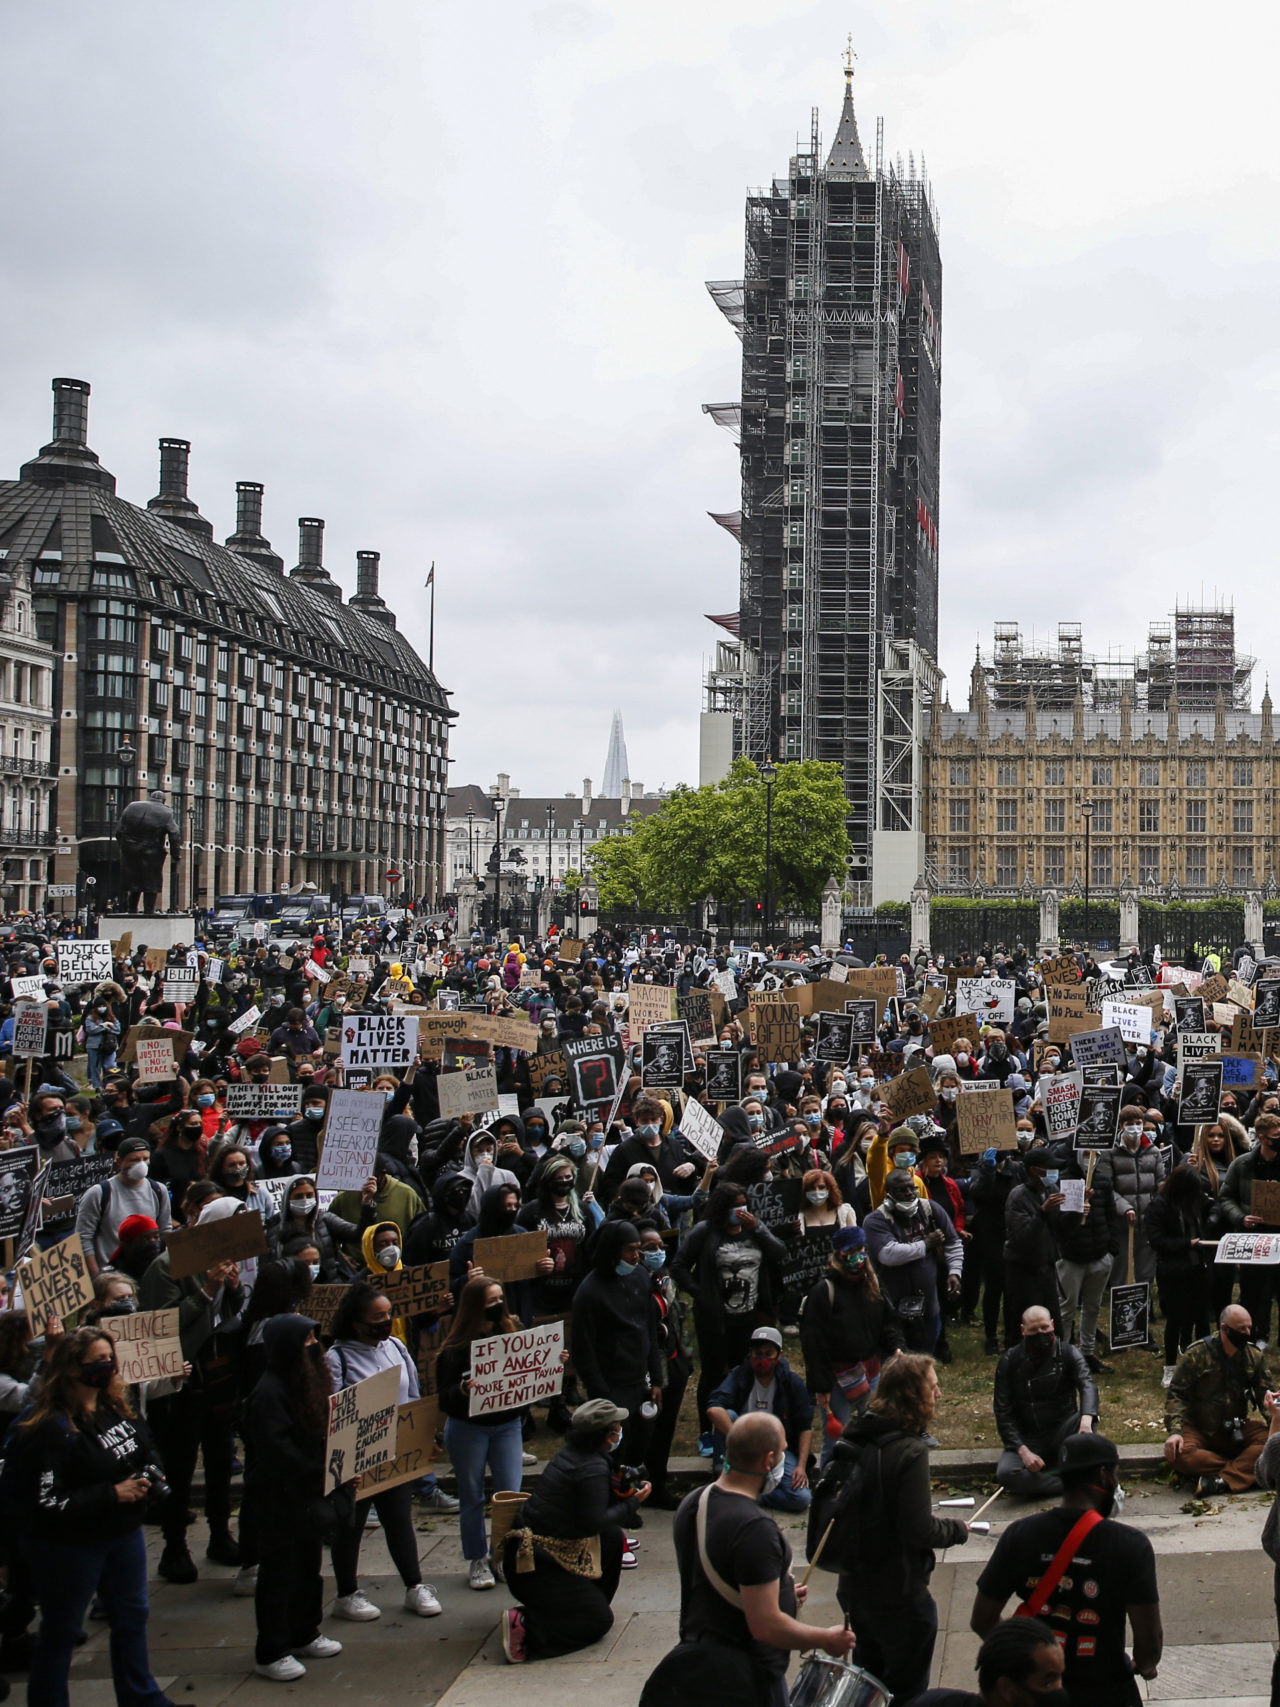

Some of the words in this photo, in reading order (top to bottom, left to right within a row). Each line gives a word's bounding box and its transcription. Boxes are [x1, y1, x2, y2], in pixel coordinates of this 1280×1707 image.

[58, 944, 110, 954] JUSTICE
[61, 960, 109, 971] BELLY
[1041, 957, 1075, 975] BLACK
[60, 971, 113, 982] MUJINGA
[169, 968, 192, 980] BLM
[850, 969, 869, 981] WHITE
[871, 969, 895, 981] SILENCE
[1044, 968, 1079, 986] LIVES
[390, 983, 409, 992] BLM
[961, 979, 983, 988] NAZI
[990, 980, 1013, 989] COPS
[750, 993, 778, 1002] WHITE
[1052, 989, 1062, 999] NO
[634, 1009, 663, 1018] WORSE
[757, 1003, 800, 1023] YOUNG
[988, 1012, 1005, 1020] OFF
[1052, 1006, 1062, 1016] NO
[1065, 1008, 1084, 1018] PEACE
[1112, 1006, 1138, 1015] BLACK
[358, 1017, 405, 1031] BLACK
[428, 1018, 468, 1033] enough
[695, 1021, 713, 1032] THIS
[931, 1018, 973, 1034] BLACK
[1111, 1017, 1138, 1027] LIVES
[357, 1032, 405, 1046] LIVES
[757, 1023, 800, 1044] GIFTED
[933, 1030, 974, 1043] LIVES
[1182, 1035, 1217, 1044] BLACK
[1239, 1031, 1280, 1042] LIVES
[566, 1036, 605, 1056] WHERE
[606, 1035, 618, 1049] IS
[1074, 1037, 1096, 1047] THERE
[1075, 1046, 1094, 1055] TIME
[1097, 1043, 1116, 1052] WHEN
[139, 1050, 172, 1059] JUSTICE
[350, 1049, 410, 1064] MATTER
[758, 1044, 800, 1064] BLACK
[1077, 1052, 1108, 1063] SILENCE
[1112, 1048, 1121, 1056] IS
[1183, 1047, 1216, 1057] LIVES
[145, 1065, 169, 1073] PEACE
[528, 1052, 567, 1073] BLACK
[466, 1069, 493, 1082] BLACK
[231, 1085, 253, 1093] THEY
[258, 1085, 279, 1093] KILL
[282, 1085, 298, 1093] OUR
[881, 1073, 920, 1096] BLACK
[1048, 1083, 1076, 1097] SMASH
[276, 1094, 299, 1102] MAKE
[467, 1088, 496, 1101] MATTER
[1046, 1091, 1080, 1105] RACISM!
[957, 1103, 994, 1114] RACISM
[1050, 1101, 1073, 1114] JOBS
[573, 1108, 599, 1124] THE
[688, 1100, 724, 1144] SILENCE
[959, 1116, 972, 1127] TO
[972, 1114, 994, 1128] DENY
[993, 1112, 1015, 1125] THAT
[335, 1117, 360, 1132] SEE
[359, 1117, 382, 1132] YOU
[1050, 1120, 1069, 1133] FOR
[680, 1122, 716, 1158] VIOLENCE
[960, 1128, 996, 1139] RACISM
[330, 1134, 363, 1149] HEAR
[960, 1137, 1001, 1150] EXISTS
[335, 1151, 374, 1165] STAND
[322, 1165, 353, 1178] WITH
[20, 1243, 71, 1290] BLACK
[370, 1266, 433, 1290] BLACK
[29, 1268, 73, 1308] LIVES
[412, 1279, 447, 1296] LIVES
[31, 1281, 88, 1337] MATTER
[108, 1313, 173, 1342] SILENCE
[136, 1343, 150, 1357] IS
[475, 1341, 497, 1358] IF
[501, 1333, 535, 1354] YOU
[536, 1333, 560, 1346] are
[119, 1351, 179, 1381] VIOLENCE
[475, 1360, 499, 1377] NOT
[508, 1375, 528, 1389] NOT
[534, 1366, 564, 1381] PAYING
[331, 1386, 358, 1411] BLACK
[480, 1380, 555, 1411] ATTENTION
[330, 1402, 357, 1424] LIVES
[358, 1405, 396, 1427] IMAGINE
[330, 1410, 360, 1437] MATTER
[356, 1427, 390, 1451] CAUGHT
[355, 1448, 366, 1460] ON
[354, 1449, 388, 1474] CAMERA
[362, 1449, 422, 1488] NEXT?
